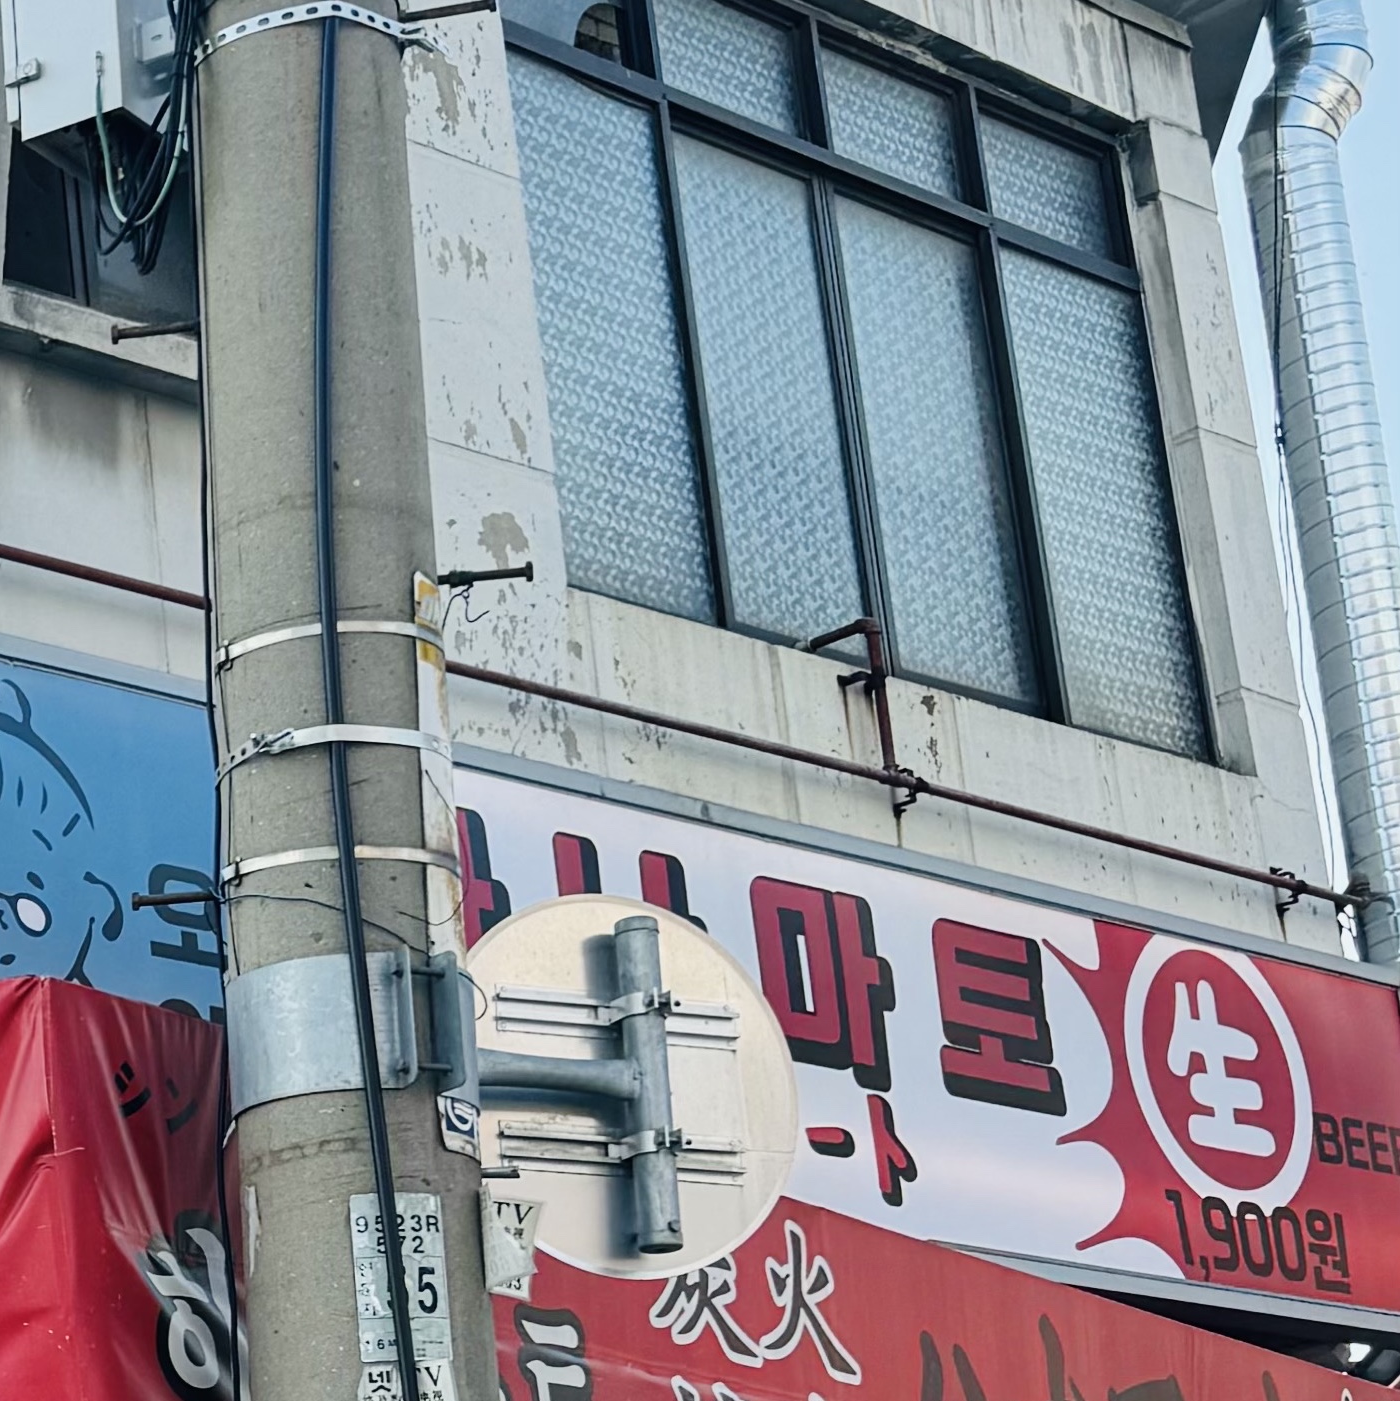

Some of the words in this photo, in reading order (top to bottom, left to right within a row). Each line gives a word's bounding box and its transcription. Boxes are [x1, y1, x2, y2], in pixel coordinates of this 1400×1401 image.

[1167, 980, 1276, 1157] 生
[1312, 1111, 1400, 1175] BEE
[1165, 1189, 1351, 1294] 1,900원
